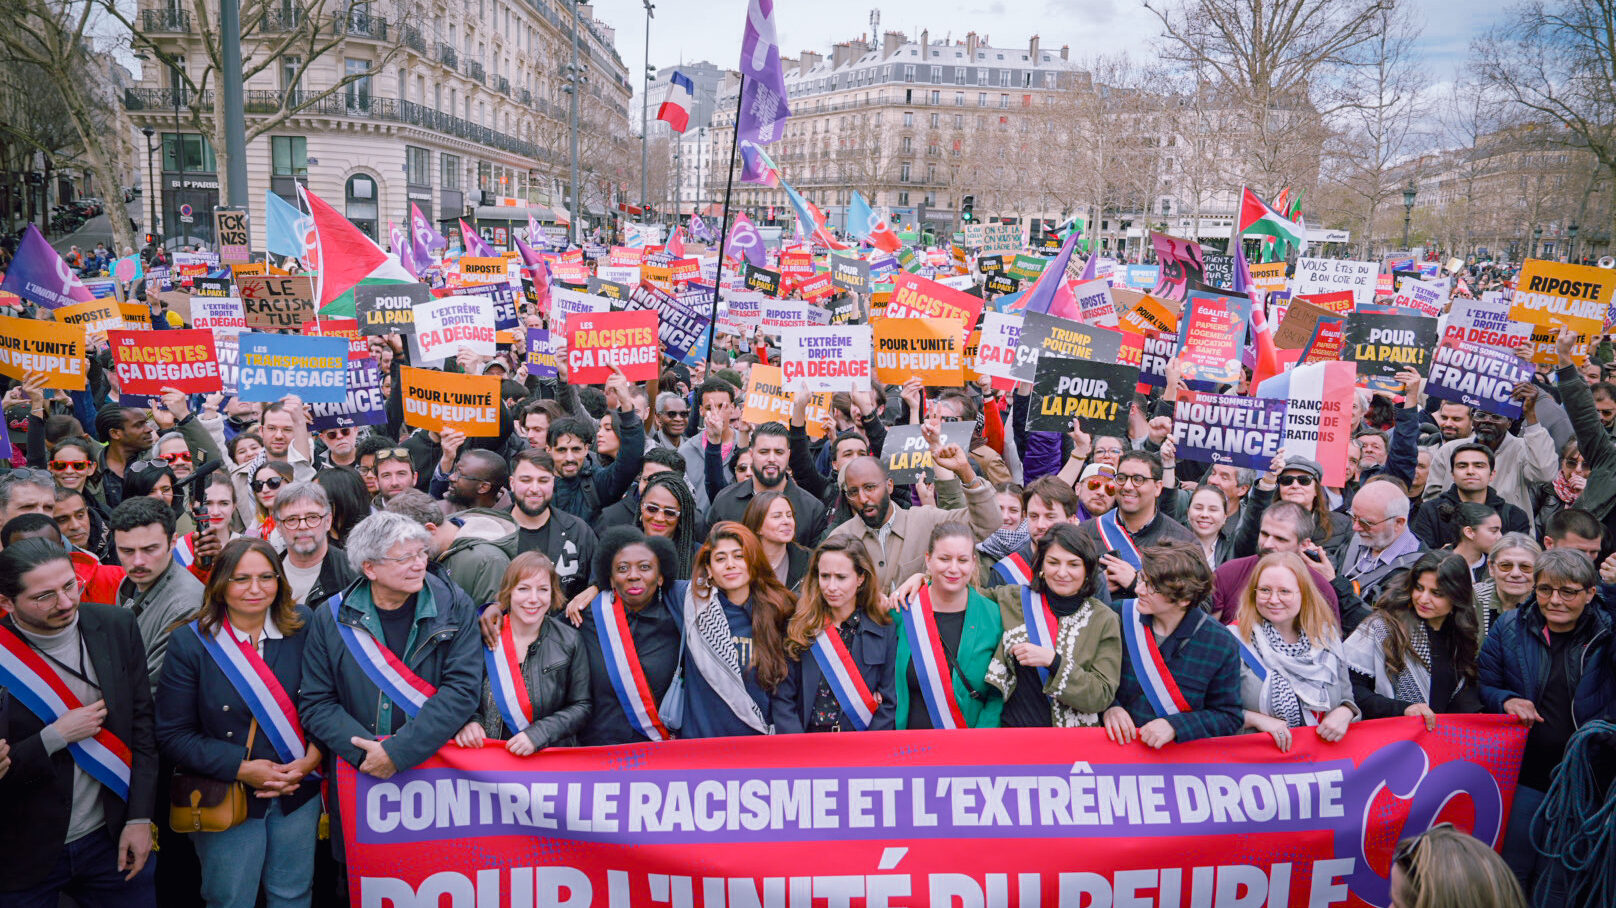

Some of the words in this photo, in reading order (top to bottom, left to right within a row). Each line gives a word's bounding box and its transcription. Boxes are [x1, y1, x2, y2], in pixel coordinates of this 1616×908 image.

[172, 180, 191, 188] BP
[217, 214, 245, 230] FCK
[221, 231, 247, 246] NZS
[466, 264, 501, 273] RIPOSTE
[838, 263, 858, 276] POUR
[1302, 260, 1328, 272] VOUS
[1358, 266, 1369, 274] DU
[753, 272, 772, 283] POUR
[834, 271, 844, 281] LA
[995, 277, 1012, 285] POUR
[1310, 273, 1329, 282] BON
[1354, 276, 1368, 285] DE
[197, 288, 208, 296] LA
[265, 280, 295, 296] LE
[803, 278, 828, 293] RIPOSTE
[907, 281, 918, 291] LES
[989, 281, 998, 289] LA
[1412, 285, 1441, 300] L'EXTRÊME
[1529, 275, 1602, 300] RIPOSTE
[244, 298, 315, 313] RACISM
[376, 296, 412, 310] POUR
[558, 299, 594, 313] L'EXTRÊME
[1080, 292, 1107, 310] RIPOSTE
[1415, 293, 1434, 304] DROITE
[1513, 290, 1609, 321] POPULAIRE
[203, 303, 239, 311] L'EXTRÊME
[431, 302, 481, 319] L'EXTRÊME
[632, 286, 705, 338] NOUVELLE
[896, 286, 971, 327] RACISTES
[1136, 305, 1156, 322] POUR
[1197, 305, 1230, 319] ÉGALITÉ
[1410, 299, 1440, 318] DÉGAGE
[266, 313, 302, 326] TUE
[367, 310, 385, 325] LA
[441, 314, 475, 327] DROITE
[766, 309, 802, 320] RIPOSTE
[1126, 311, 1142, 326] DU
[580, 321, 593, 330] LES
[761, 318, 806, 327] ANTIFASCISTE
[1195, 321, 1229, 332] PAPIERS
[1472, 319, 1509, 332] DROITE
[122, 338, 135, 346] LES
[420, 330, 442, 353] ÇA
[443, 321, 495, 343] DÉGAGE
[575, 327, 653, 349] RACISTES
[799, 333, 853, 347] L'EXTRÊME
[1051, 326, 1092, 347] TRUMP
[1159, 333, 1176, 341] NOUS
[1190, 328, 1233, 341] LOGEMENT
[1370, 328, 1415, 347] POUR
[1467, 326, 1529, 349] DÉGAGE
[0, 334, 20, 350] OUR
[24, 340, 77, 356] L'UNITÉ
[253, 345, 267, 353] LES
[880, 338, 908, 351] POUR
[910, 336, 955, 351] L'UNITÉ
[1043, 337, 1094, 360] POUTINE
[1188, 337, 1233, 348] ÉDUCATION
[1195, 345, 1222, 355] SANTÉ
[119, 344, 209, 363] RACISTES
[569, 350, 595, 372] ÇA
[597, 343, 657, 367] DÉGAGE
[808, 348, 842, 359] DROITE
[980, 343, 1001, 365] ÇA
[1016, 344, 1040, 367] ÇA
[1355, 344, 1377, 361] LA
[1459, 341, 1479, 353] NOUS
[1479, 346, 1510, 361] SOMMES
[1510, 356, 1519, 366] LA
[12, 353, 81, 375] PEUPLE
[245, 353, 343, 369] TRANSPHOBES
[877, 352, 897, 369] DU
[900, 352, 960, 371] PEUPLE
[1436, 345, 1531, 383] NOUVELLE
[117, 362, 145, 384] ÇA
[146, 359, 218, 381] DÉGAGE
[783, 361, 805, 383] ÇA
[808, 356, 869, 378] DÉGAGE
[241, 367, 269, 390] ÇA
[271, 365, 345, 388] DÉGAGE
[1057, 376, 1108, 399] POUR
[409, 386, 441, 402] POUR
[443, 391, 492, 406] L'UNITÉ
[748, 393, 770, 411] DU
[1195, 394, 1217, 404] NOUS
[1218, 395, 1253, 408] SOMMES
[1253, 399, 1264, 409] LA
[405, 397, 428, 416] DU
[431, 404, 497, 423] PEUPLE
[1041, 395, 1063, 416] LA
[1175, 401, 1283, 431] NOUVELLE
[1287, 414, 1321, 426] TISSU
[1323, 416, 1339, 427] DE
[1171, 421, 1281, 458] FRANCE
[889, 452, 909, 471] LA
[365, 778, 559, 834] CONTRE
[565, 782, 621, 833] LE
[628, 778, 840, 833] RACISME
[848, 778, 904, 828] ET
[911, 760, 1172, 828] L'EXTRÊME
[1172, 768, 1346, 824] DROITE
